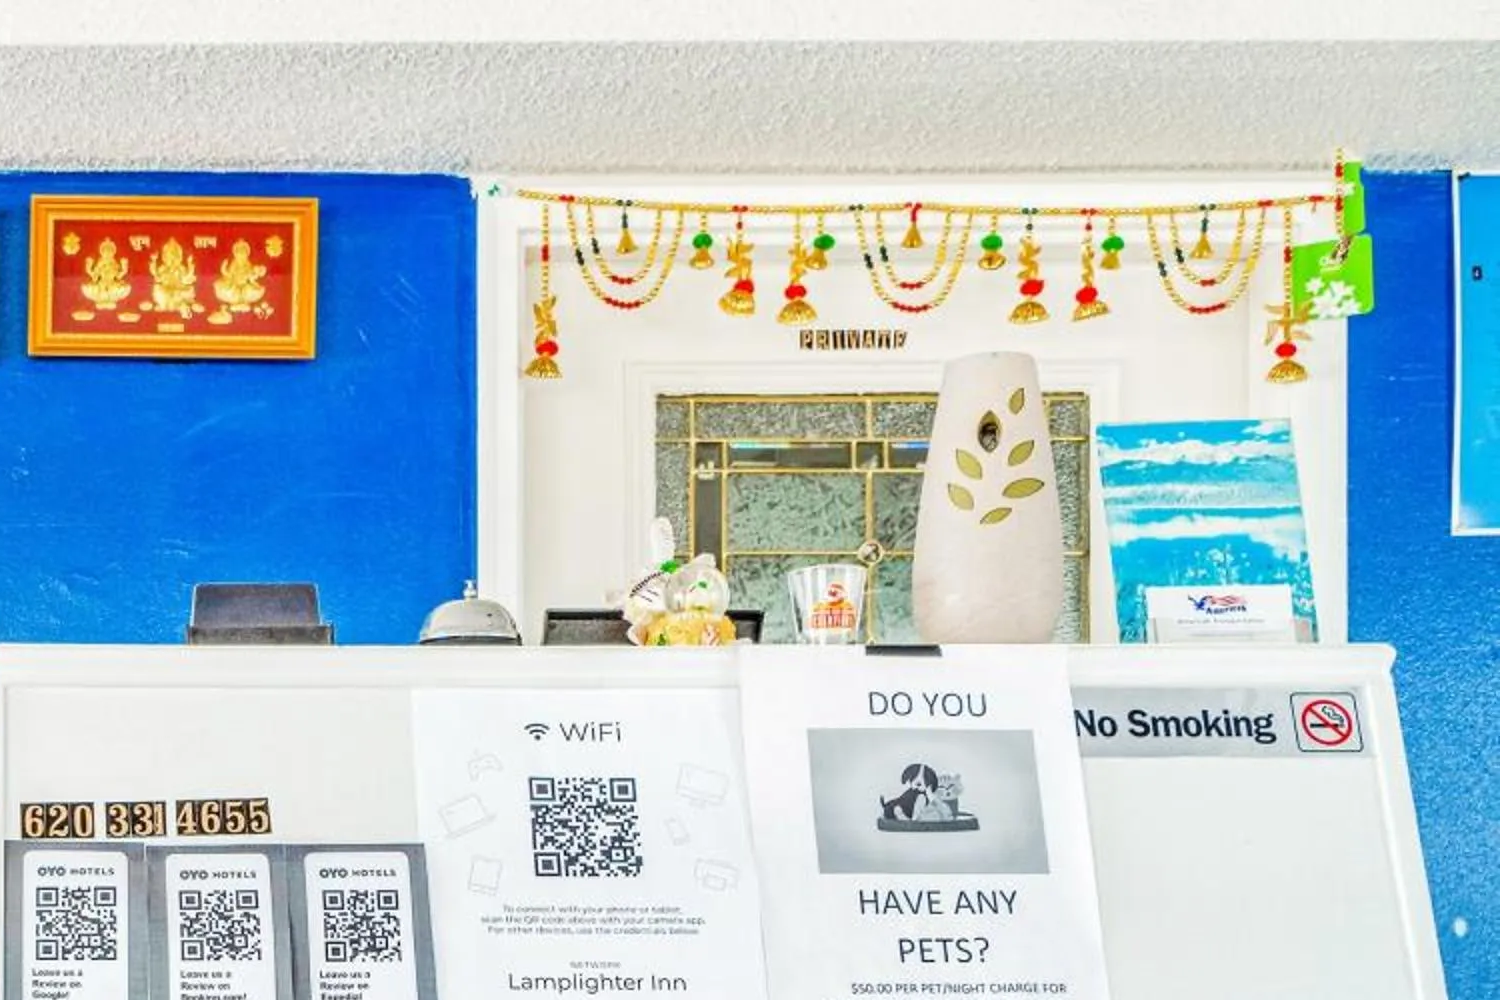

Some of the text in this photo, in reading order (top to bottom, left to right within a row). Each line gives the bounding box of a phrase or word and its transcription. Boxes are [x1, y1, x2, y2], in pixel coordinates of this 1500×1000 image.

[868, 691, 987, 717] DO YOU
[559, 722, 622, 742] WiFi
[1073, 709, 1277, 744] No Smoking
[23, 801, 268, 837] 620 331 4655
[38, 867, 115, 876] OYO HOTELS
[180, 870, 257, 880] OYO HOTELS
[319, 868, 397, 878] OYO HOTELS
[859, 890, 1017, 915] HAVE ANY
[898, 938, 989, 963] PETS?
[32, 979, 67, 988] Review
[181, 982, 215, 991] Review
[320, 981, 354, 990] Review
[508, 973, 687, 994] Lamplighter Inn
[851, 983, 1068, 995] $50.00 PER PET/NIGHT CHARGE FOR
